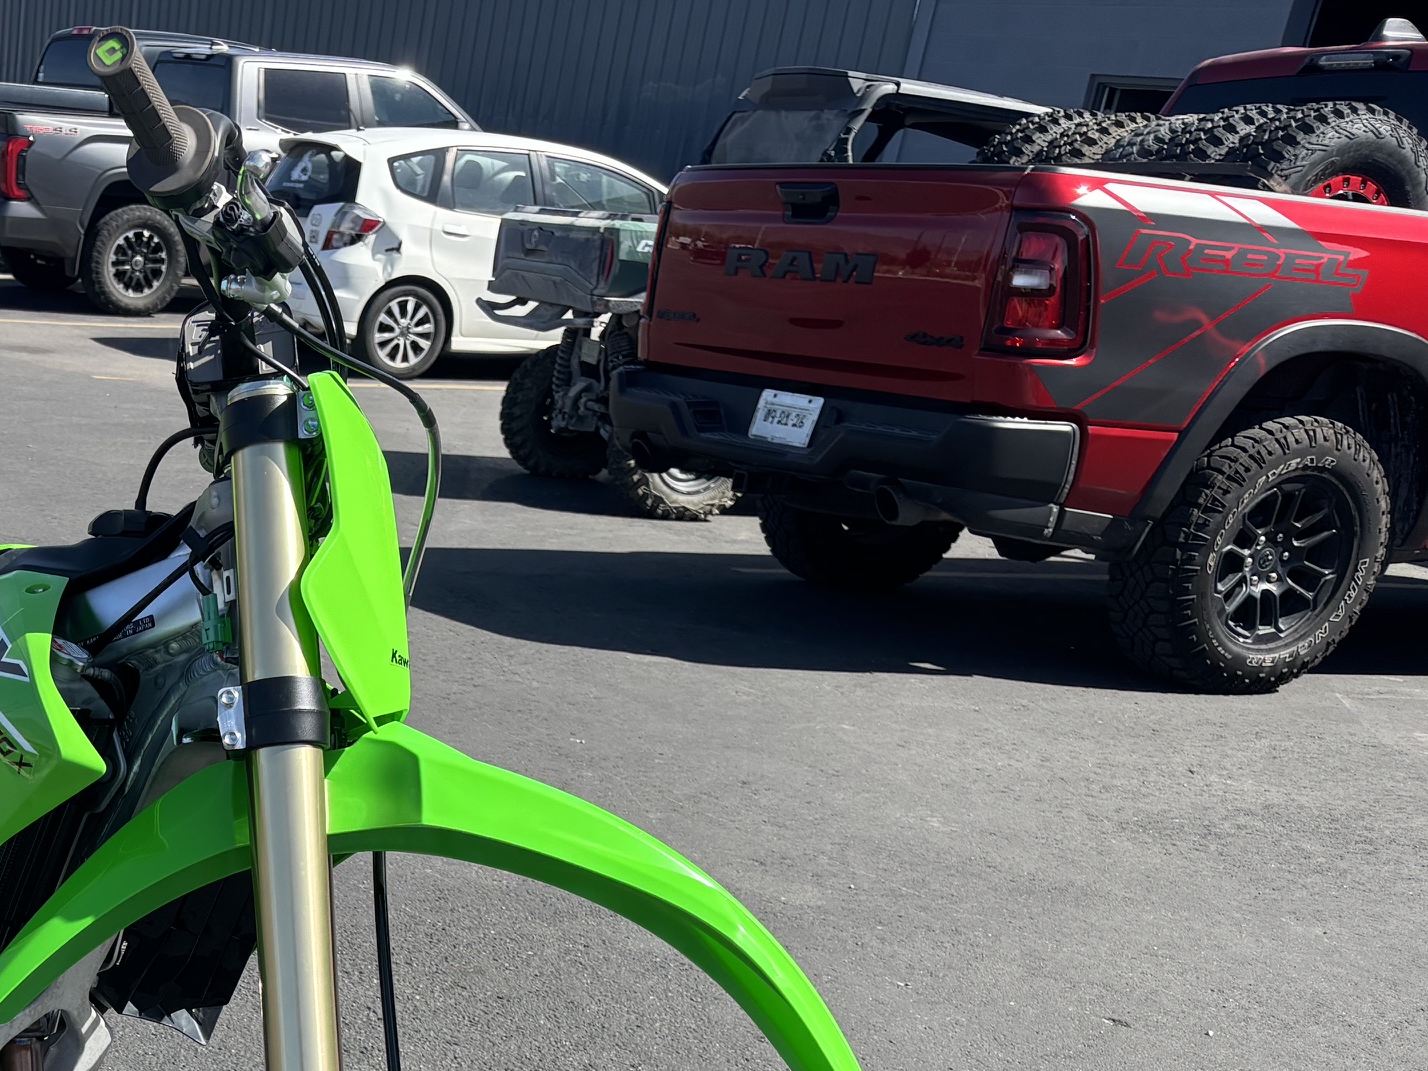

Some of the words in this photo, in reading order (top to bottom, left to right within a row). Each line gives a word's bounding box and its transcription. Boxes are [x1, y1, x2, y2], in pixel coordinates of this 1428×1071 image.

[724, 247, 878, 285] RAM
[1115, 228, 1367, 291] REBEL
[1206, 455, 1337, 575] GOODYEAR
[1246, 558, 1370, 667] WRANGLER
[390, 648, 410, 669] Kaw
